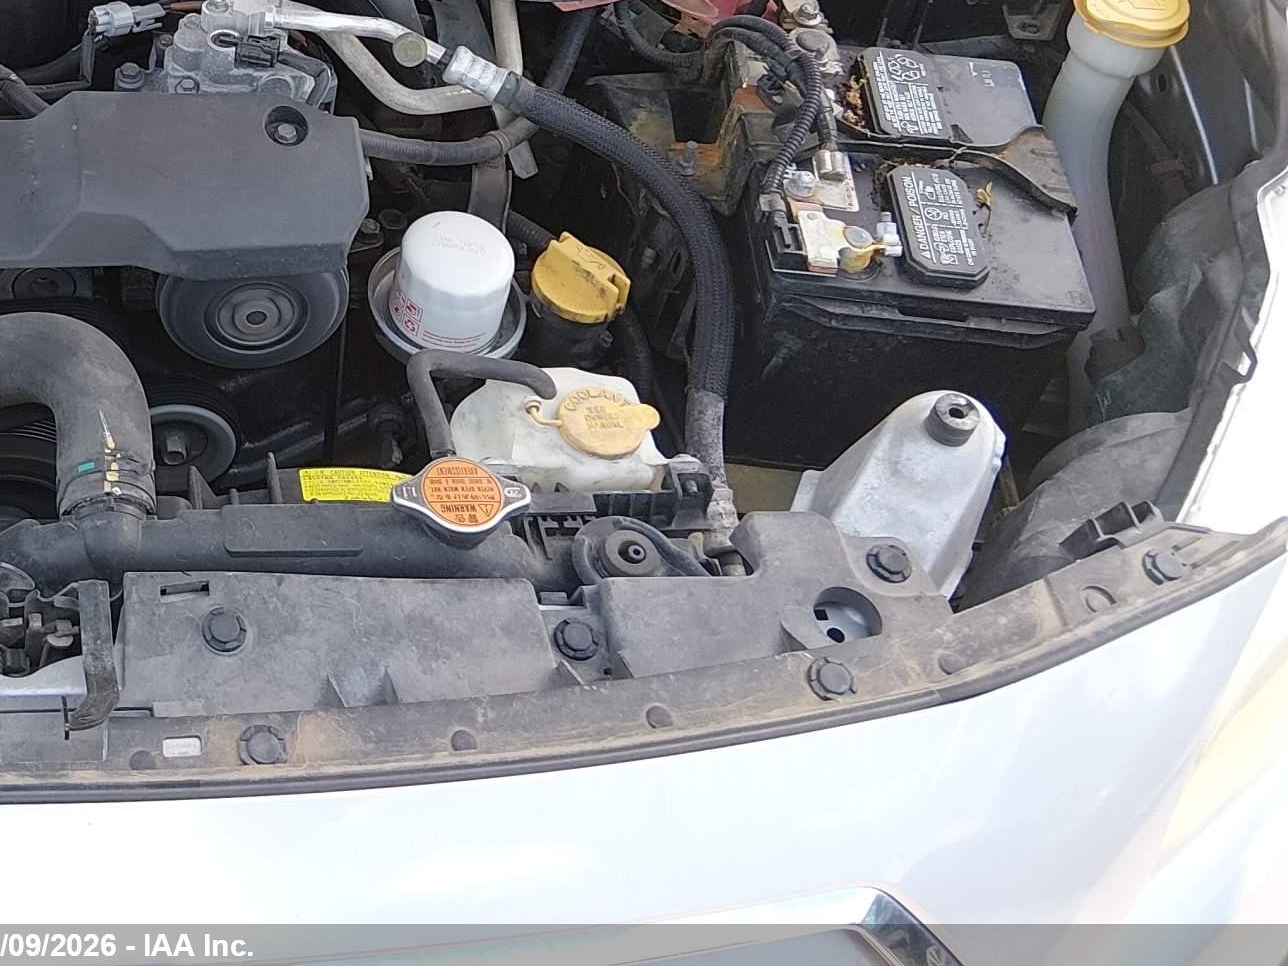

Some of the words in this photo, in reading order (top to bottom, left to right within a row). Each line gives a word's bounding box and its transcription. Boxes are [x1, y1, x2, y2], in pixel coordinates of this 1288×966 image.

[902, 176, 918, 208] POISON
[912, 214, 931, 250] DANGER
[564, 389, 632, 412] COOLANT
[440, 503, 478, 513] WARNING
